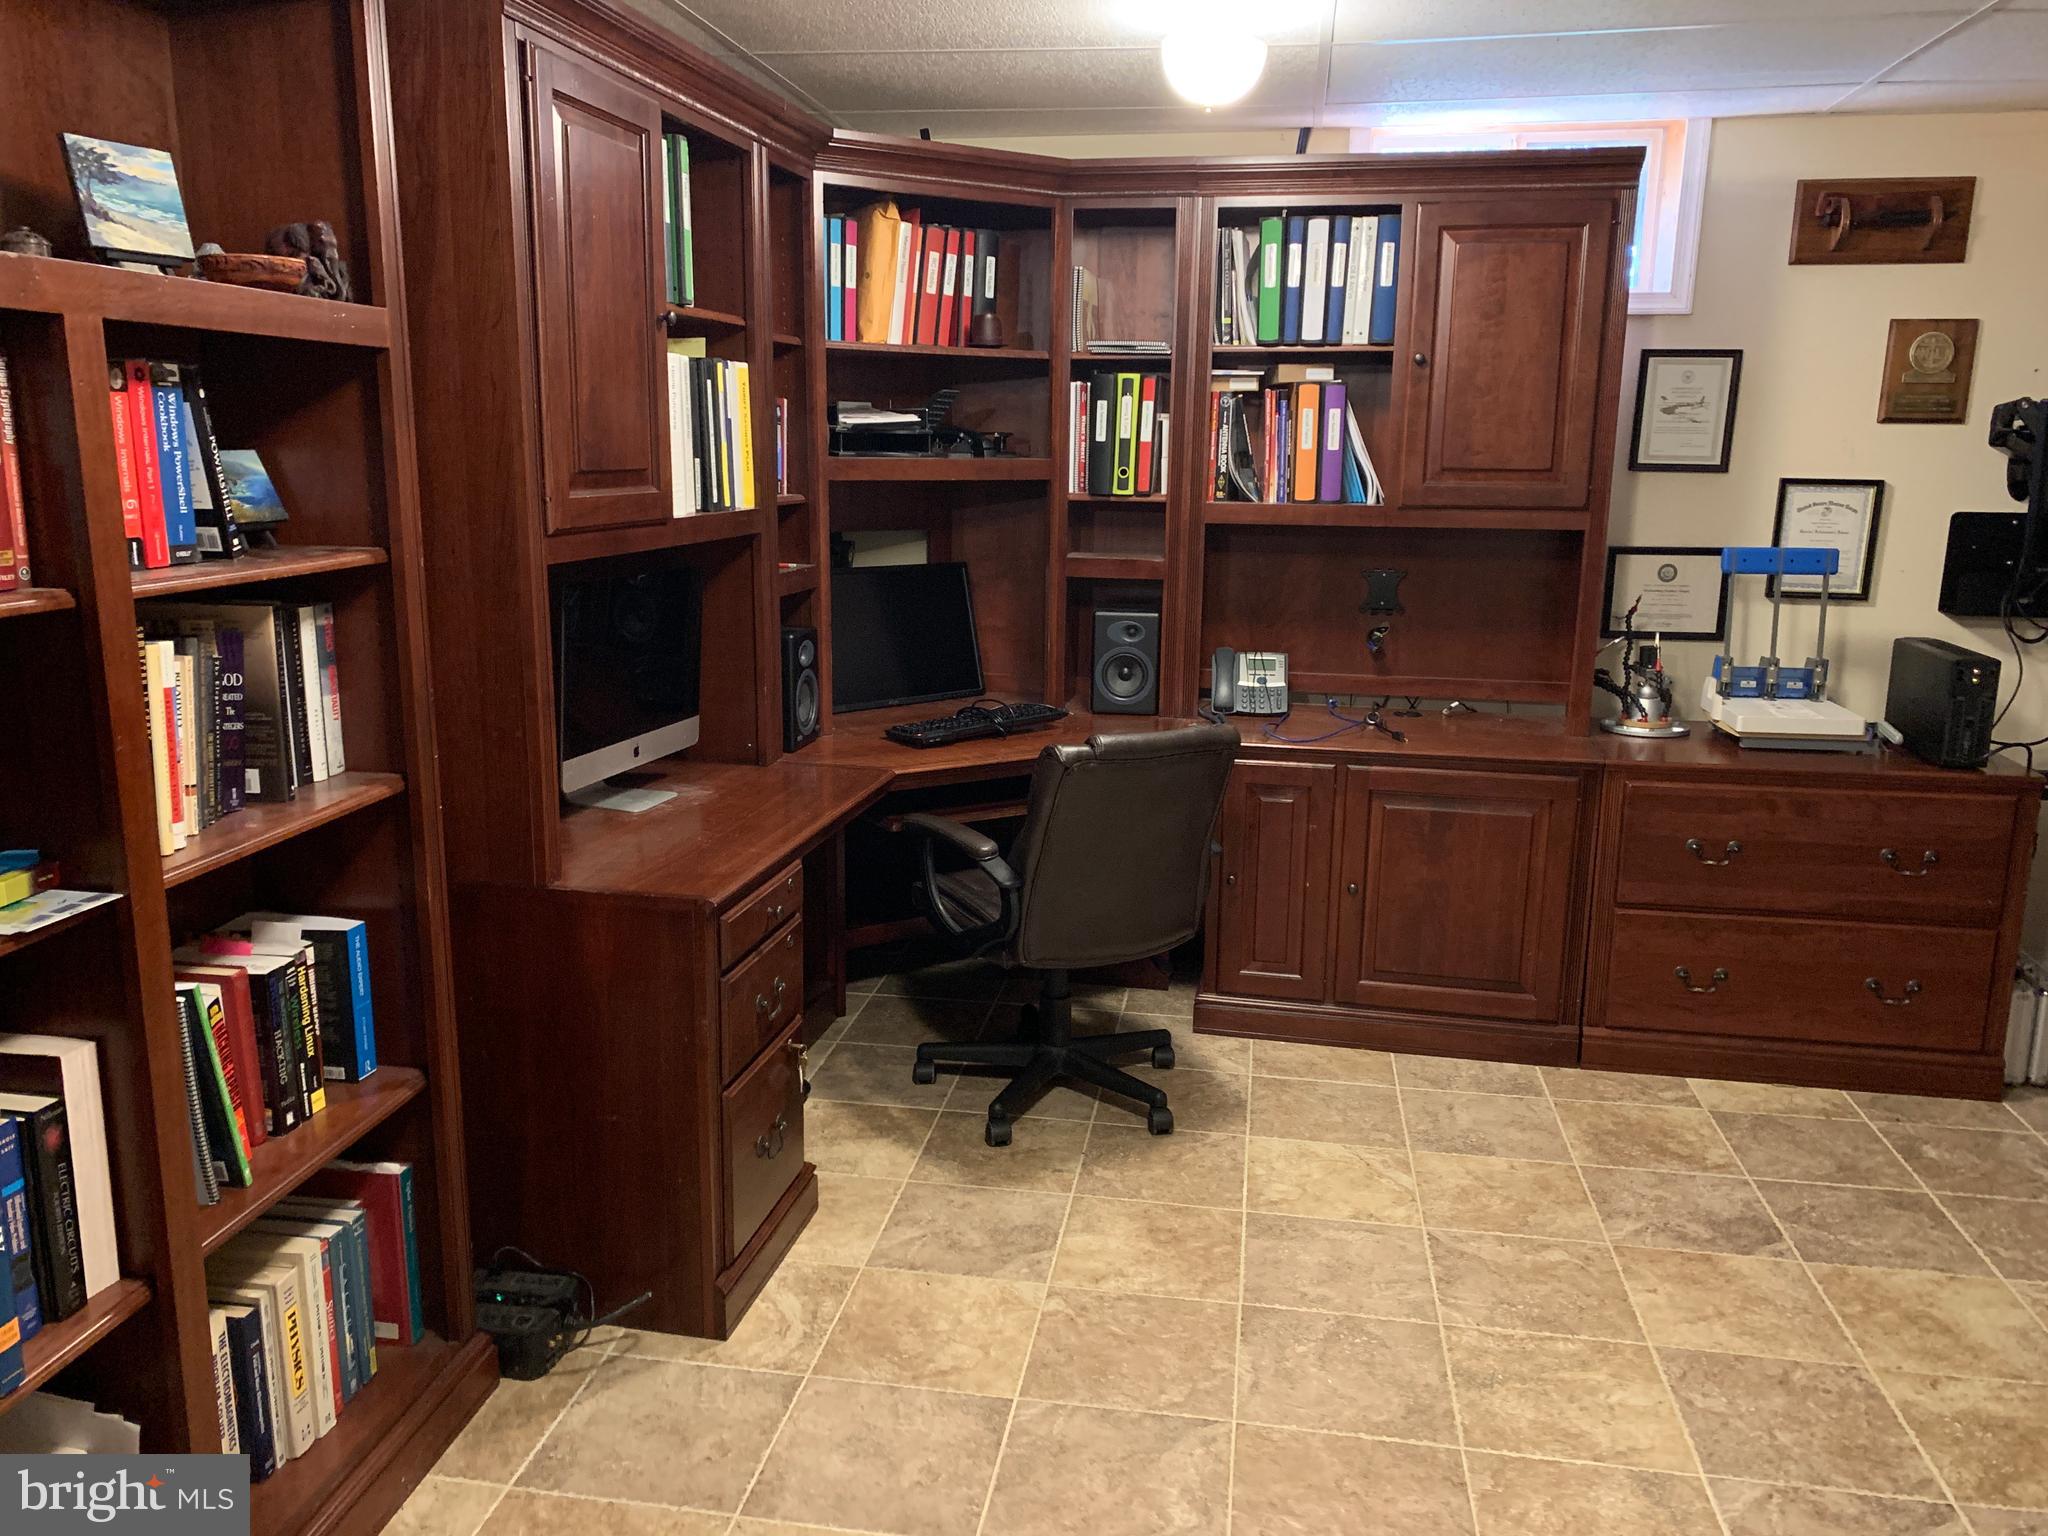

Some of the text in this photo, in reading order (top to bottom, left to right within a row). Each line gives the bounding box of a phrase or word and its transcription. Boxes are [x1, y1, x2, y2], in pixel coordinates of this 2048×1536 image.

[0, 390, 16, 444] Cryptography
[136, 387, 148, 426] Windows
[158, 392, 170, 452] Cookbook
[114, 396, 138, 510] Windows Internals 6
[168, 393, 188, 514] Windows PowerShell
[209, 436, 234, 522] POWERSHELL
[222, 673, 243, 686] OD
[225, 706, 236, 716] The
[291, 992, 304, 1050] Wireless
[297, 966, 316, 1058] Hardening Linux
[213, 1025, 241, 1112] HACKING EXPOSED
[274, 1029, 287, 1085] HACKING
[57, 1162, 79, 1274] ELECTRIC CIRCUITS
[286, 1310, 304, 1391] PHYSICS
[218, 1331, 237, 1452] THE ELECTROMAGNETICS
